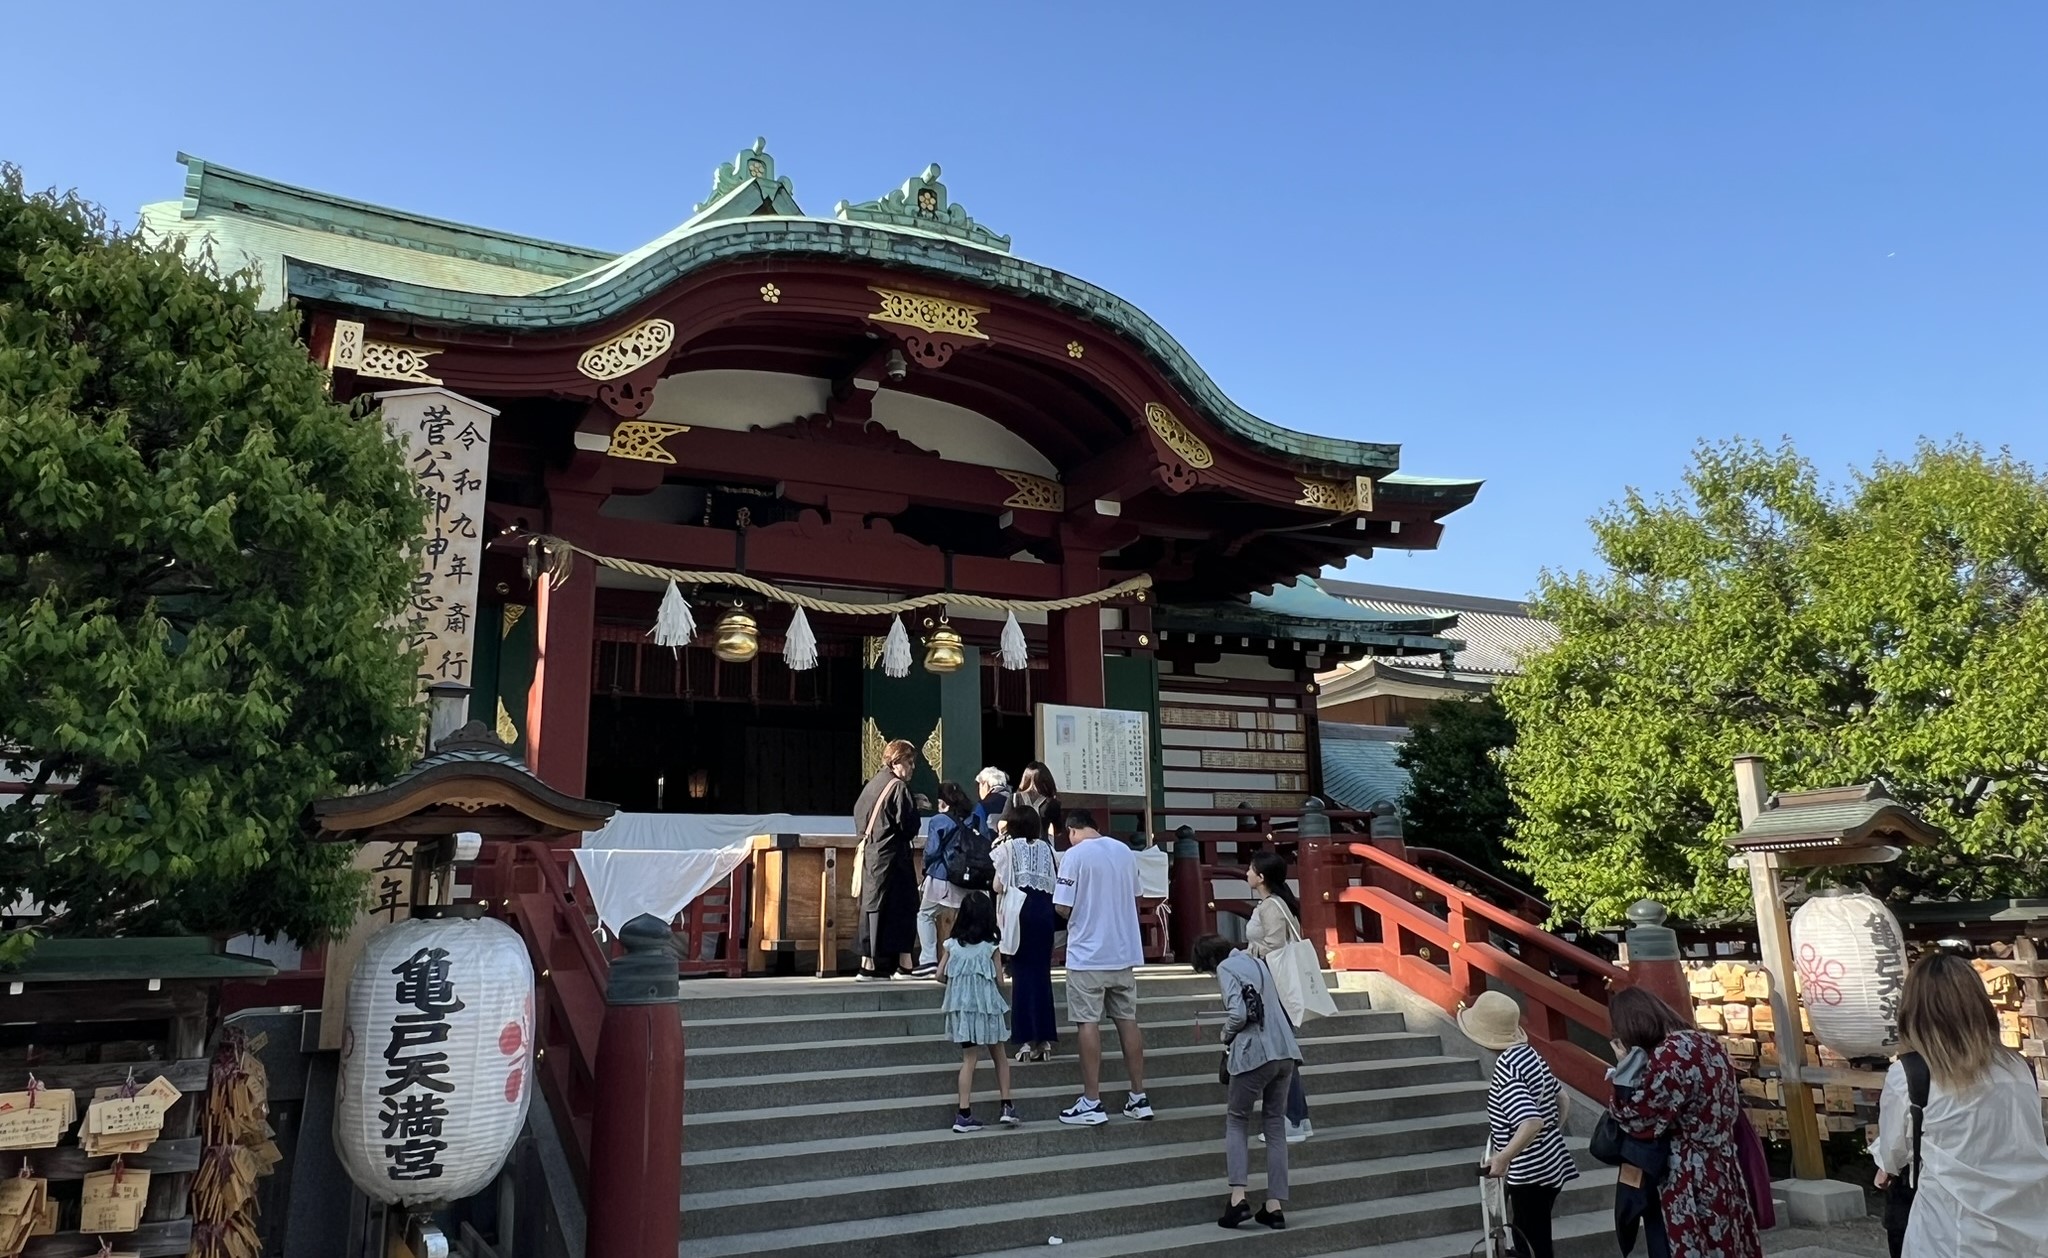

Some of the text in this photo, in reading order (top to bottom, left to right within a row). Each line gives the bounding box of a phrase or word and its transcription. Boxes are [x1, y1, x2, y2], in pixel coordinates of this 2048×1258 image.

[378, 947, 466, 1181] 亀戸天満宮
